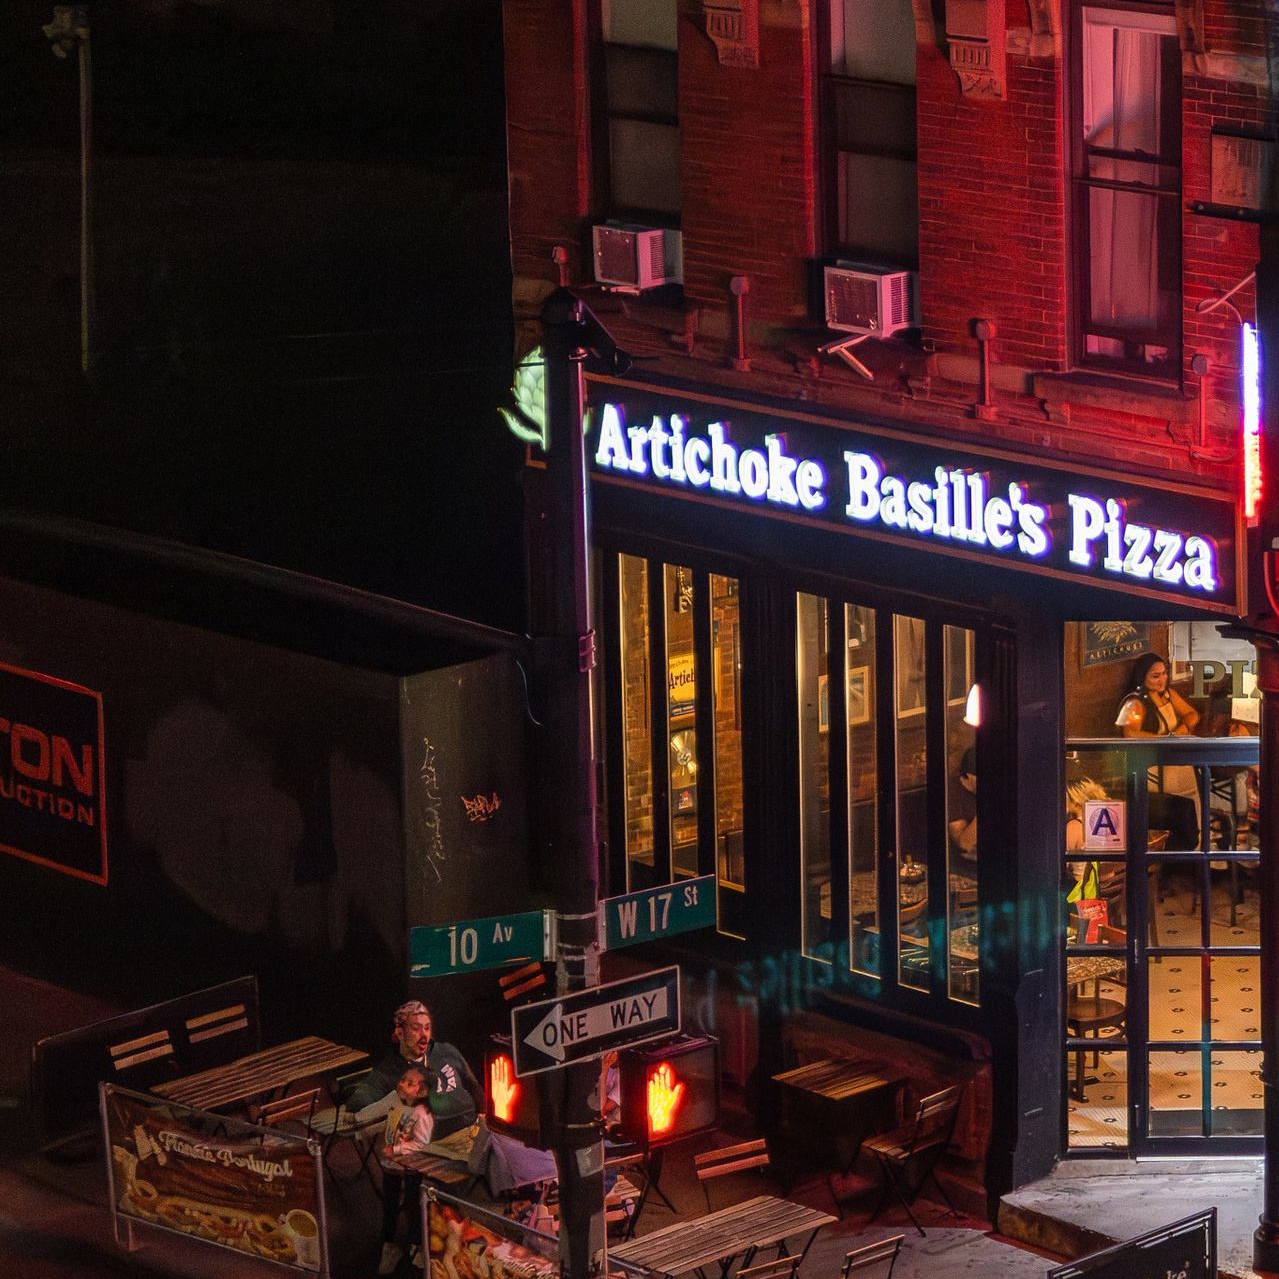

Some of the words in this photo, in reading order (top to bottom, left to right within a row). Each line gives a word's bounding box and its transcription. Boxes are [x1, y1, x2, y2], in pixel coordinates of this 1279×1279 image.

[595, 402, 828, 510] Artichoke
[844, 450, 1051, 556] Basille's
[1067, 493, 1217, 592] Pizza
[1092, 808, 1118, 836] A
[617, 900, 638, 939] W
[648, 893, 673, 933] 17
[684, 885, 699, 908] St
[447, 926, 479, 967] 10
[492, 922, 514, 944] Av
[542, 1013, 589, 1048] ONE
[610, 993, 658, 1029] WAY
